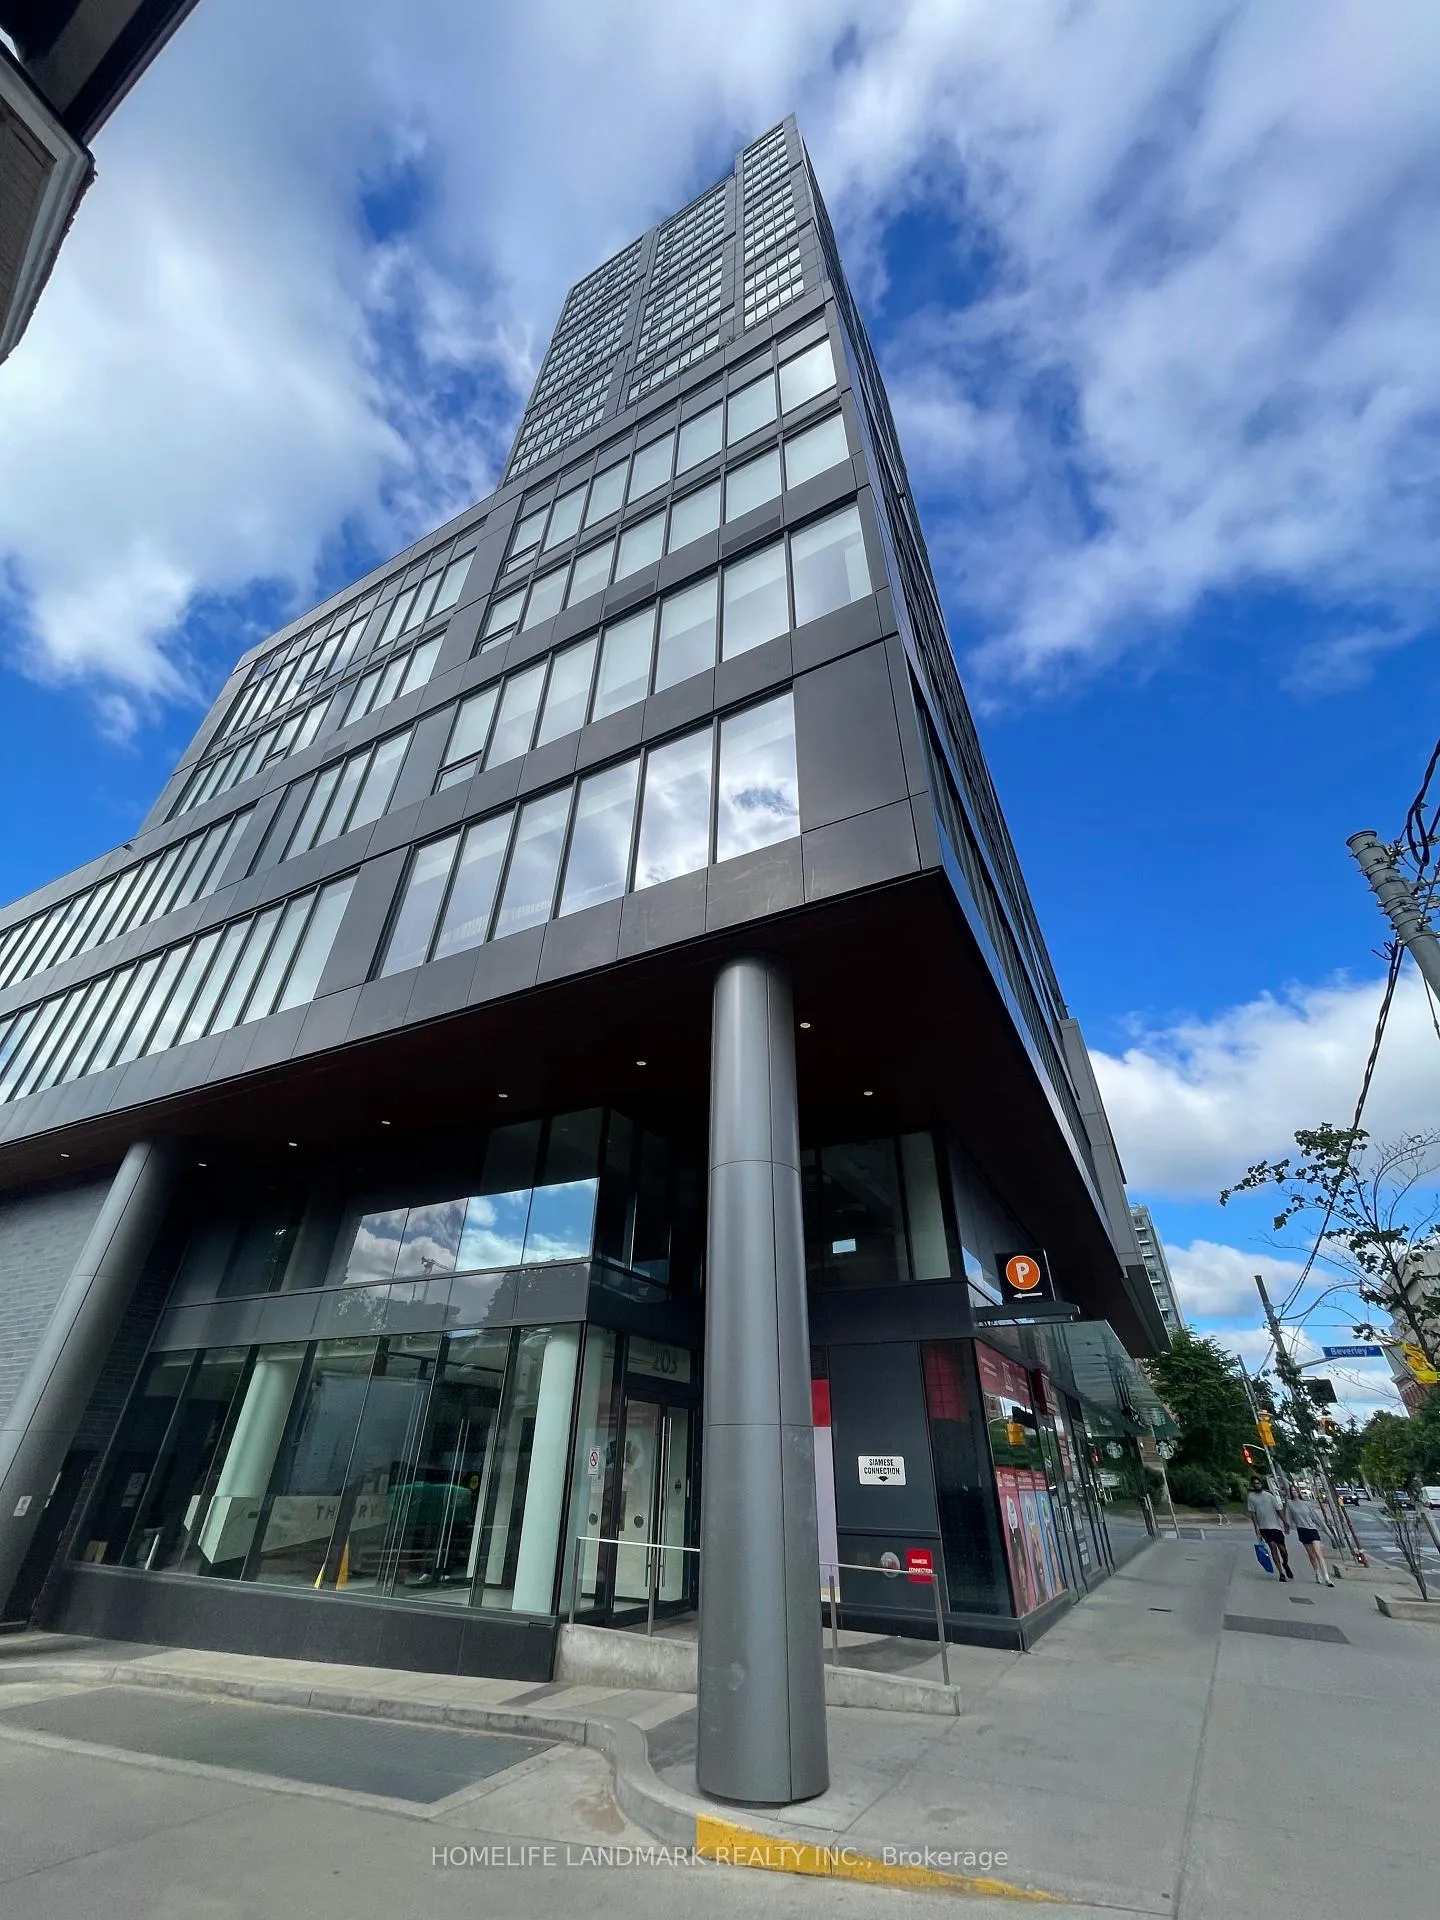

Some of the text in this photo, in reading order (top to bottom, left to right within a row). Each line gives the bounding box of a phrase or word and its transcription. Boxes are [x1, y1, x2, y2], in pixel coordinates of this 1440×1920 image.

[1015, 1262, 1030, 1284] P
[1330, 1347, 1368, 1356] Beverley
[869, 1458, 894, 1467] SIAMESE
[863, 1466, 900, 1475] CONNECTION
[316, 1502, 379, 1521] THRY
